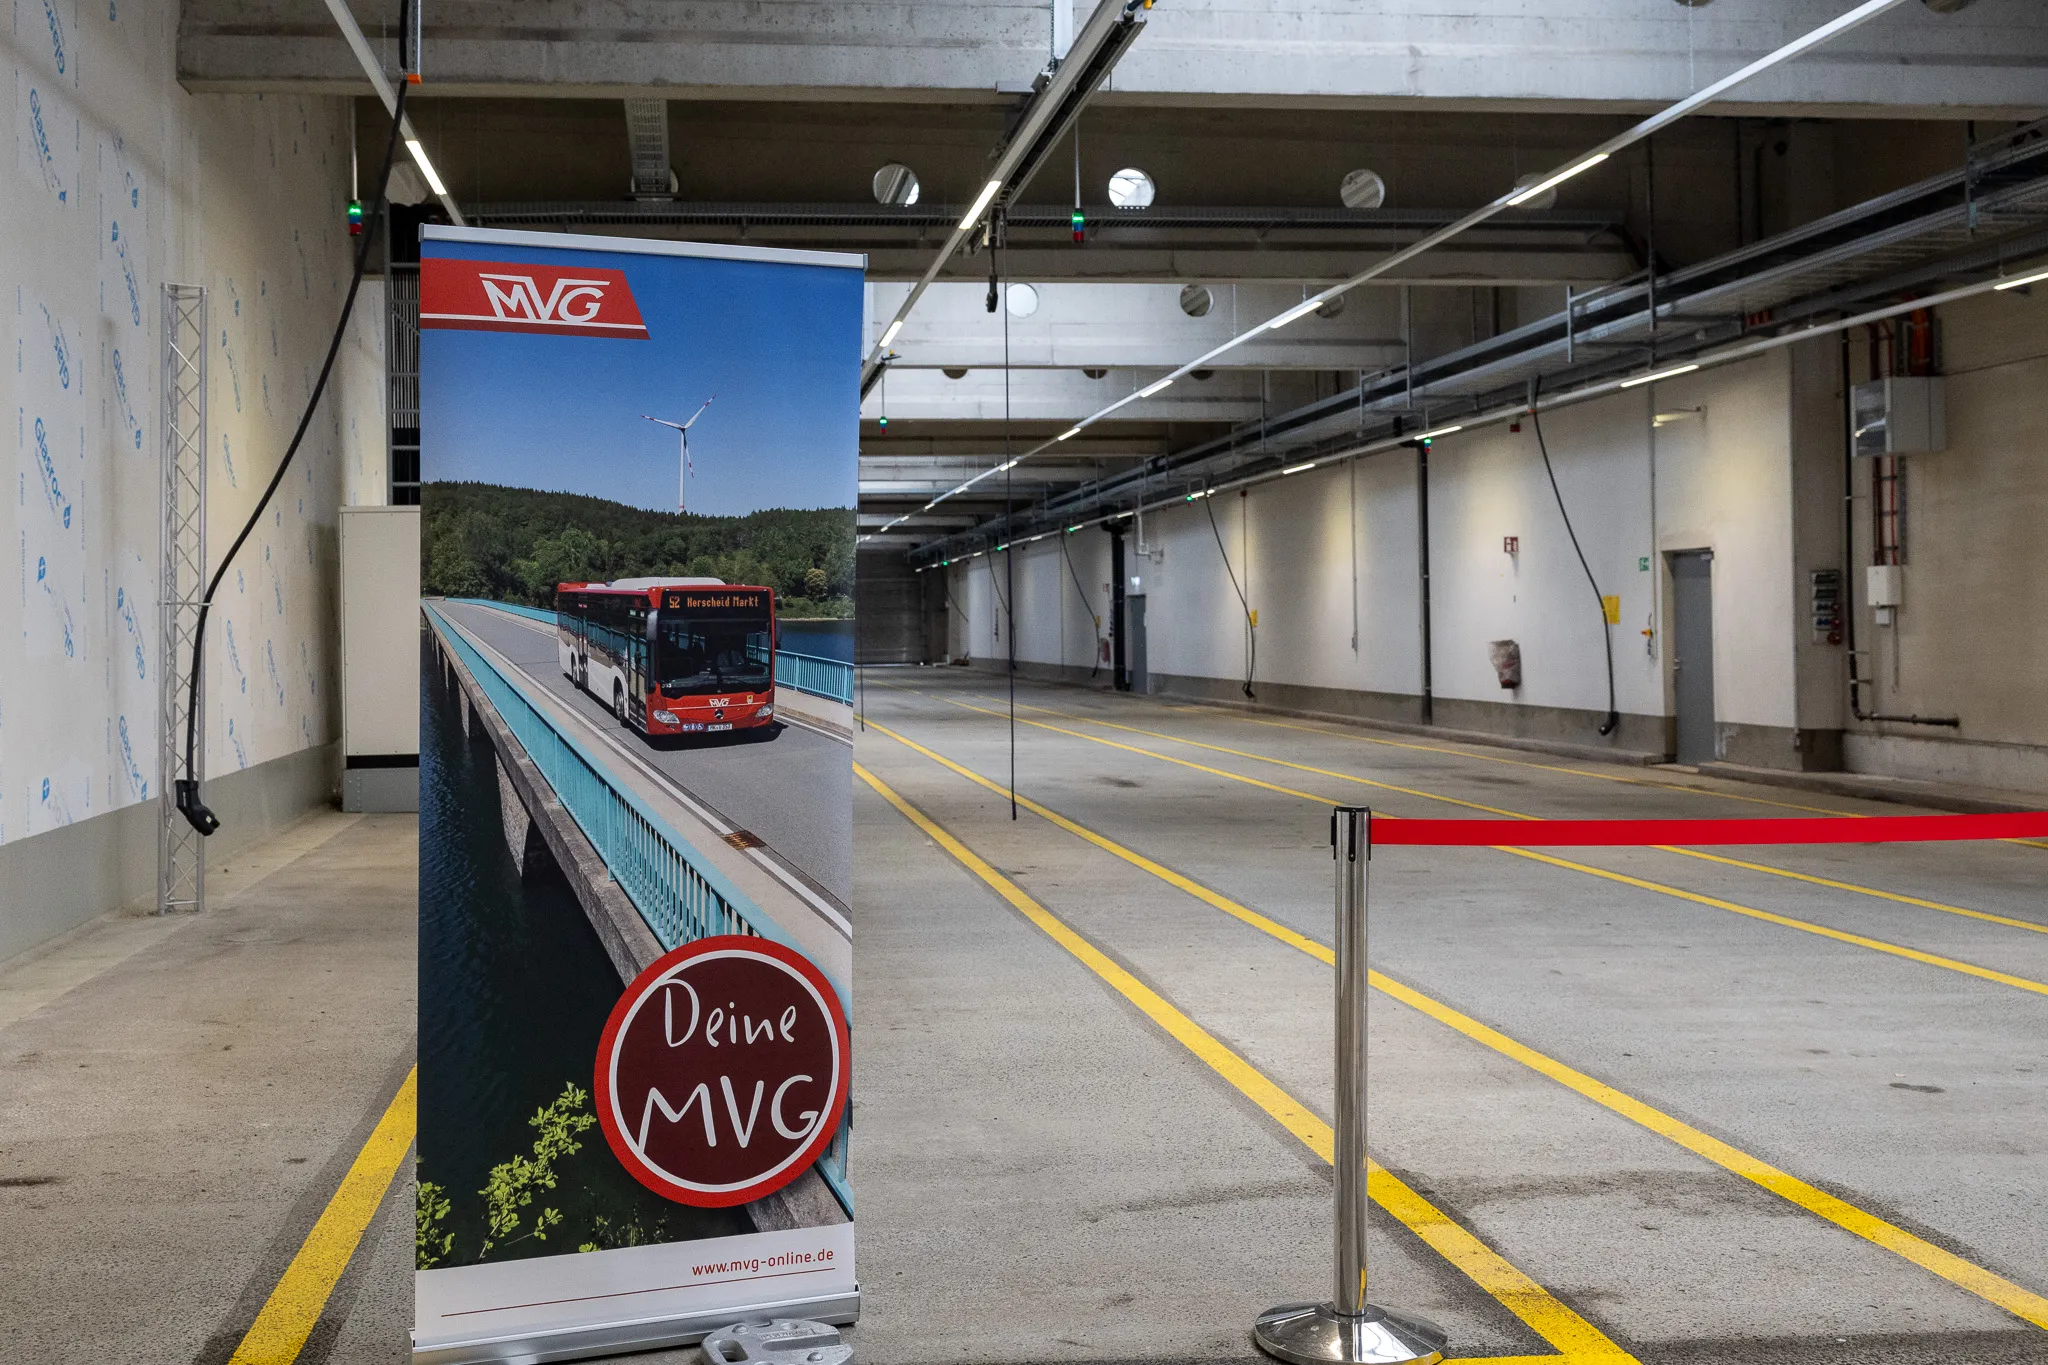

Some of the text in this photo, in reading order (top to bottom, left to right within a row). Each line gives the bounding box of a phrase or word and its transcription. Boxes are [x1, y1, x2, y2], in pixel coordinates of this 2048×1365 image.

[479, 273, 610, 323] MVG
[687, 596, 730, 607] Herscheid
[733, 595, 759, 607] Markt
[709, 698, 730, 708] MVG
[661, 978, 797, 1048] Deine
[638, 1075, 819, 1154] MVG
[692, 1248, 834, 1276] www.mvg-online.de
